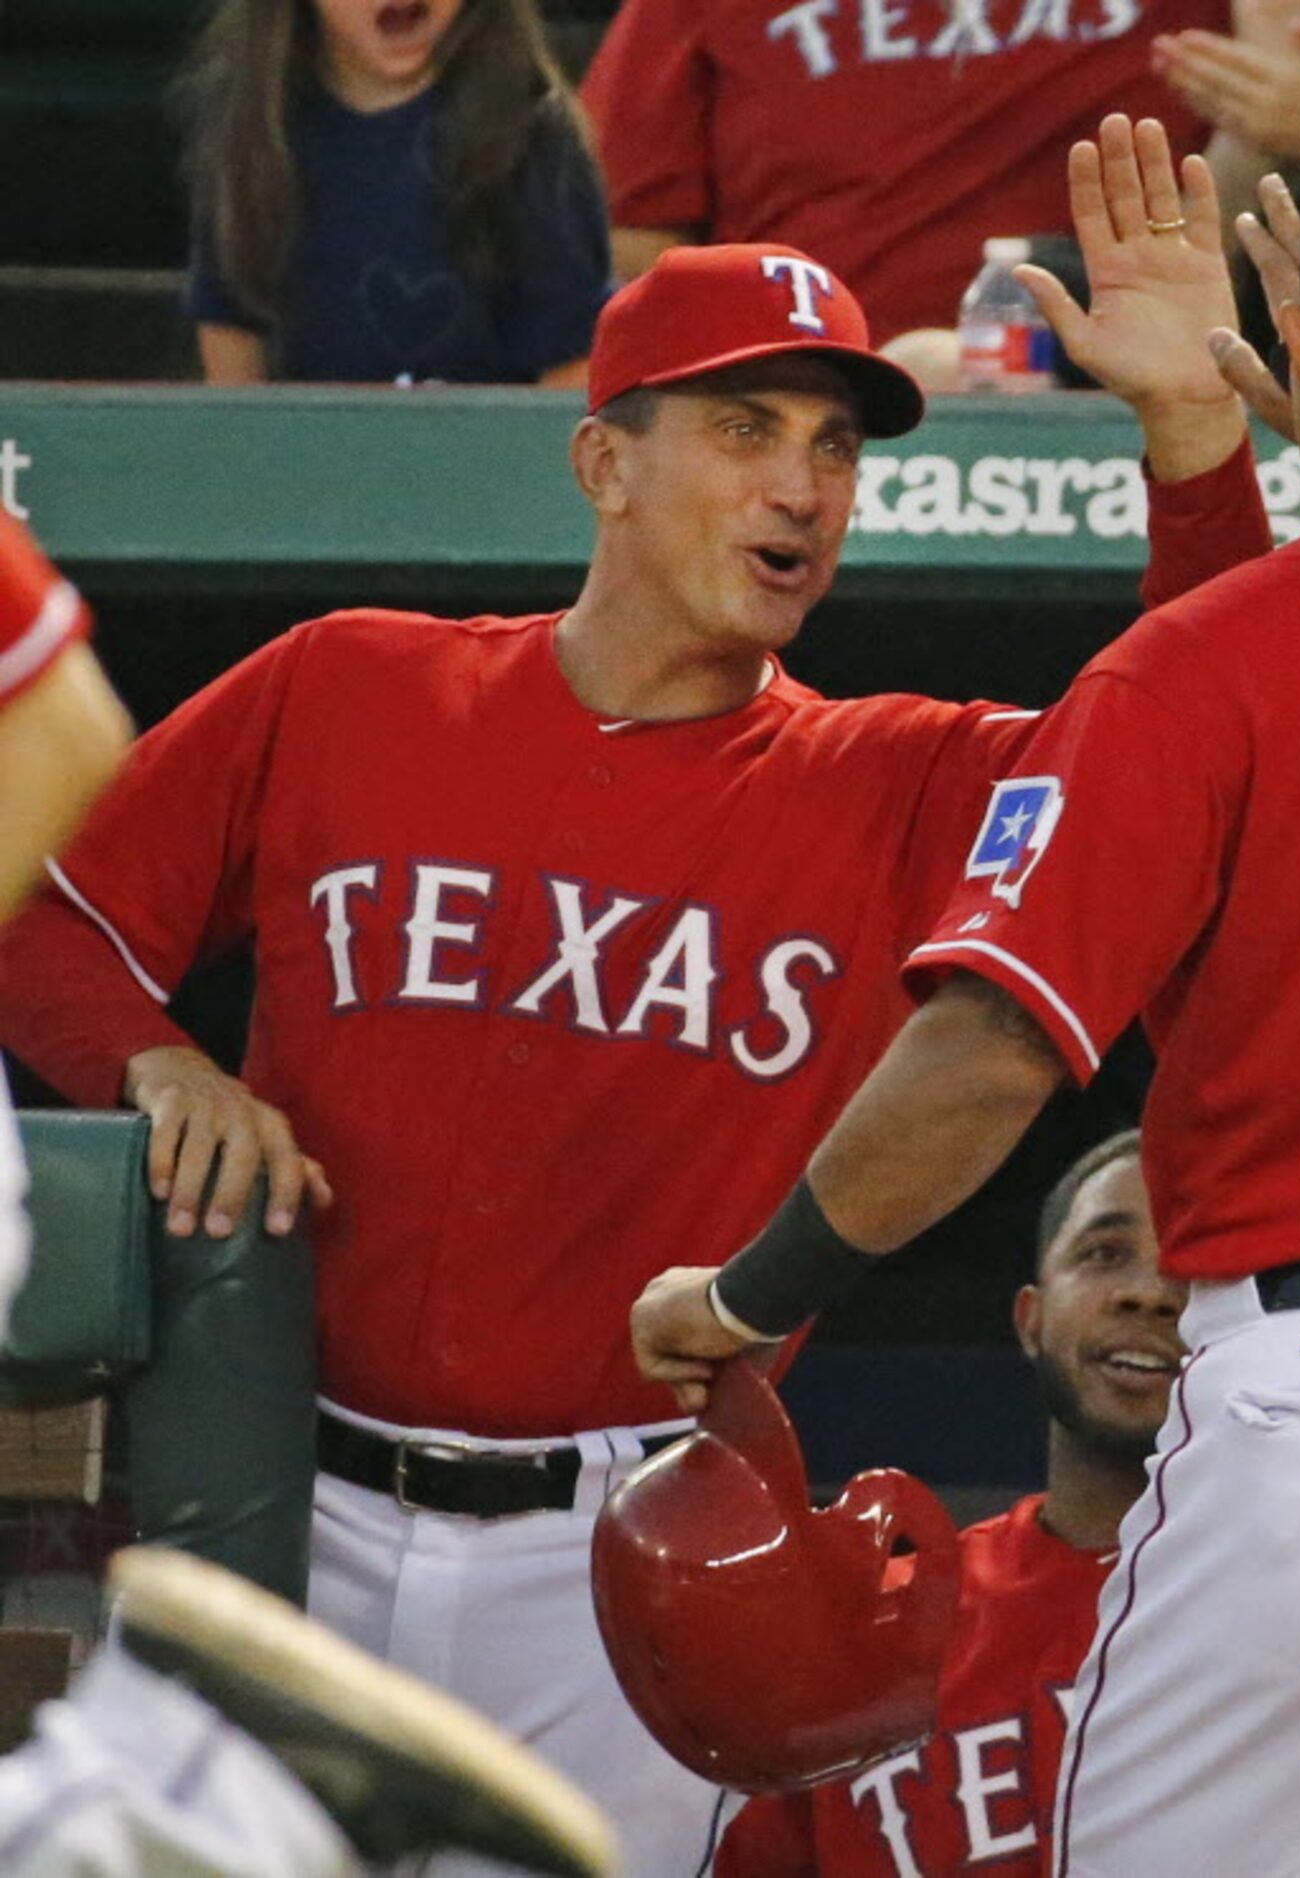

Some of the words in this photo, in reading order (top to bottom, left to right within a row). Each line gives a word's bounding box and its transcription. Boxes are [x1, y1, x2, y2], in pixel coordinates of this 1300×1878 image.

[761, 255, 832, 336] T
[309, 862, 838, 1079] TEXAS
[851, 1685, 1072, 1878] TE
